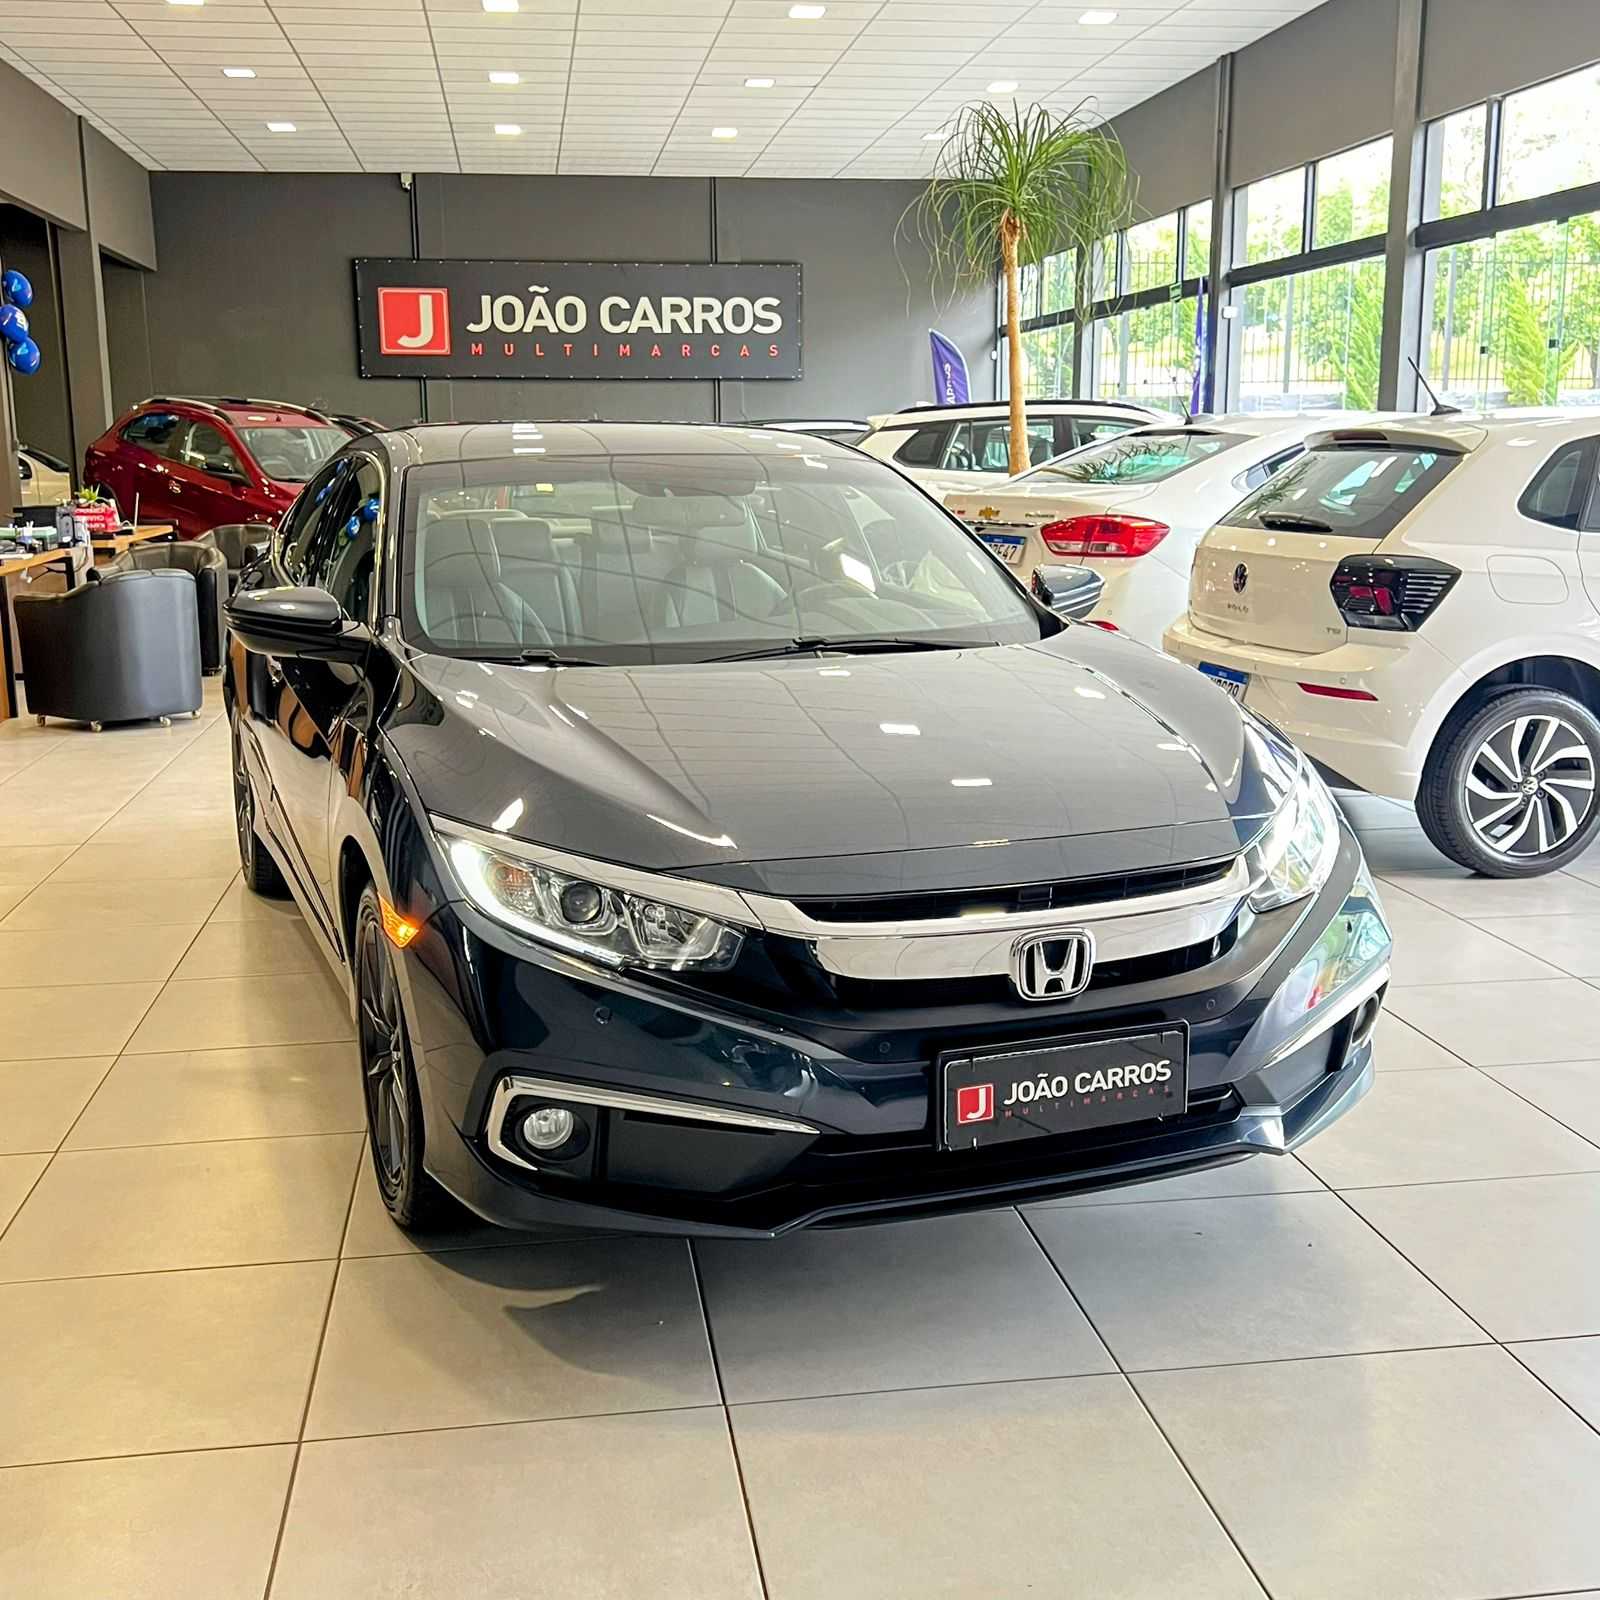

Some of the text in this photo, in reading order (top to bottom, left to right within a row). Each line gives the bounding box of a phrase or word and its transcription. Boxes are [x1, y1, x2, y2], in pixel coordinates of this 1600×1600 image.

[397, 293, 433, 348] J
[466, 285, 783, 335] JOÃO CARROS
[471, 343, 780, 357] MULTIMARCAS
[966, 1087, 987, 1119] J
[1004, 1060, 1172, 1106] JOÃO CARROS
[1004, 1085, 1171, 1119] MULTIMARCAS
